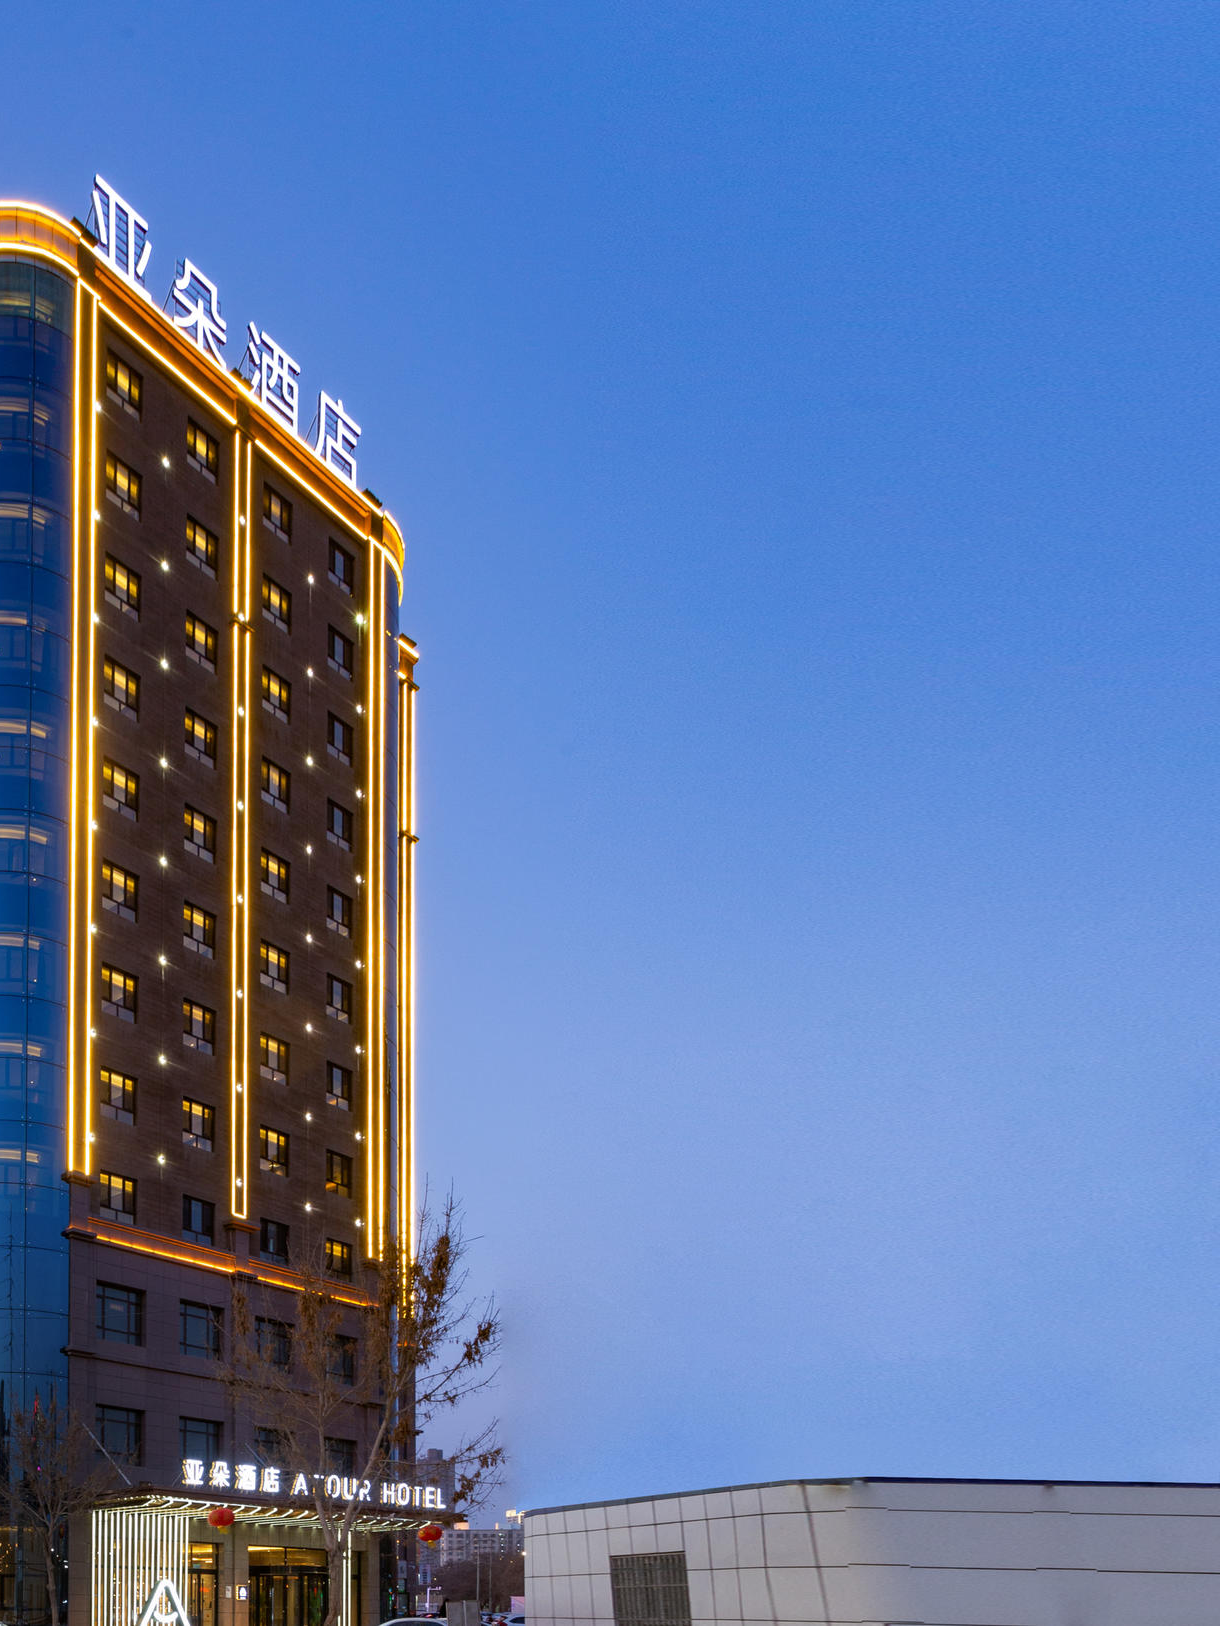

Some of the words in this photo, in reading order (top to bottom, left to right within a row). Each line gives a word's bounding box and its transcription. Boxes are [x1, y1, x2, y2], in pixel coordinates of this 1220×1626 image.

[92, 174, 361, 489] 亚朵酒店
[182, 1459, 280, 1492] 亚朵酒店
[381, 1482, 446, 1509] HOTEL
